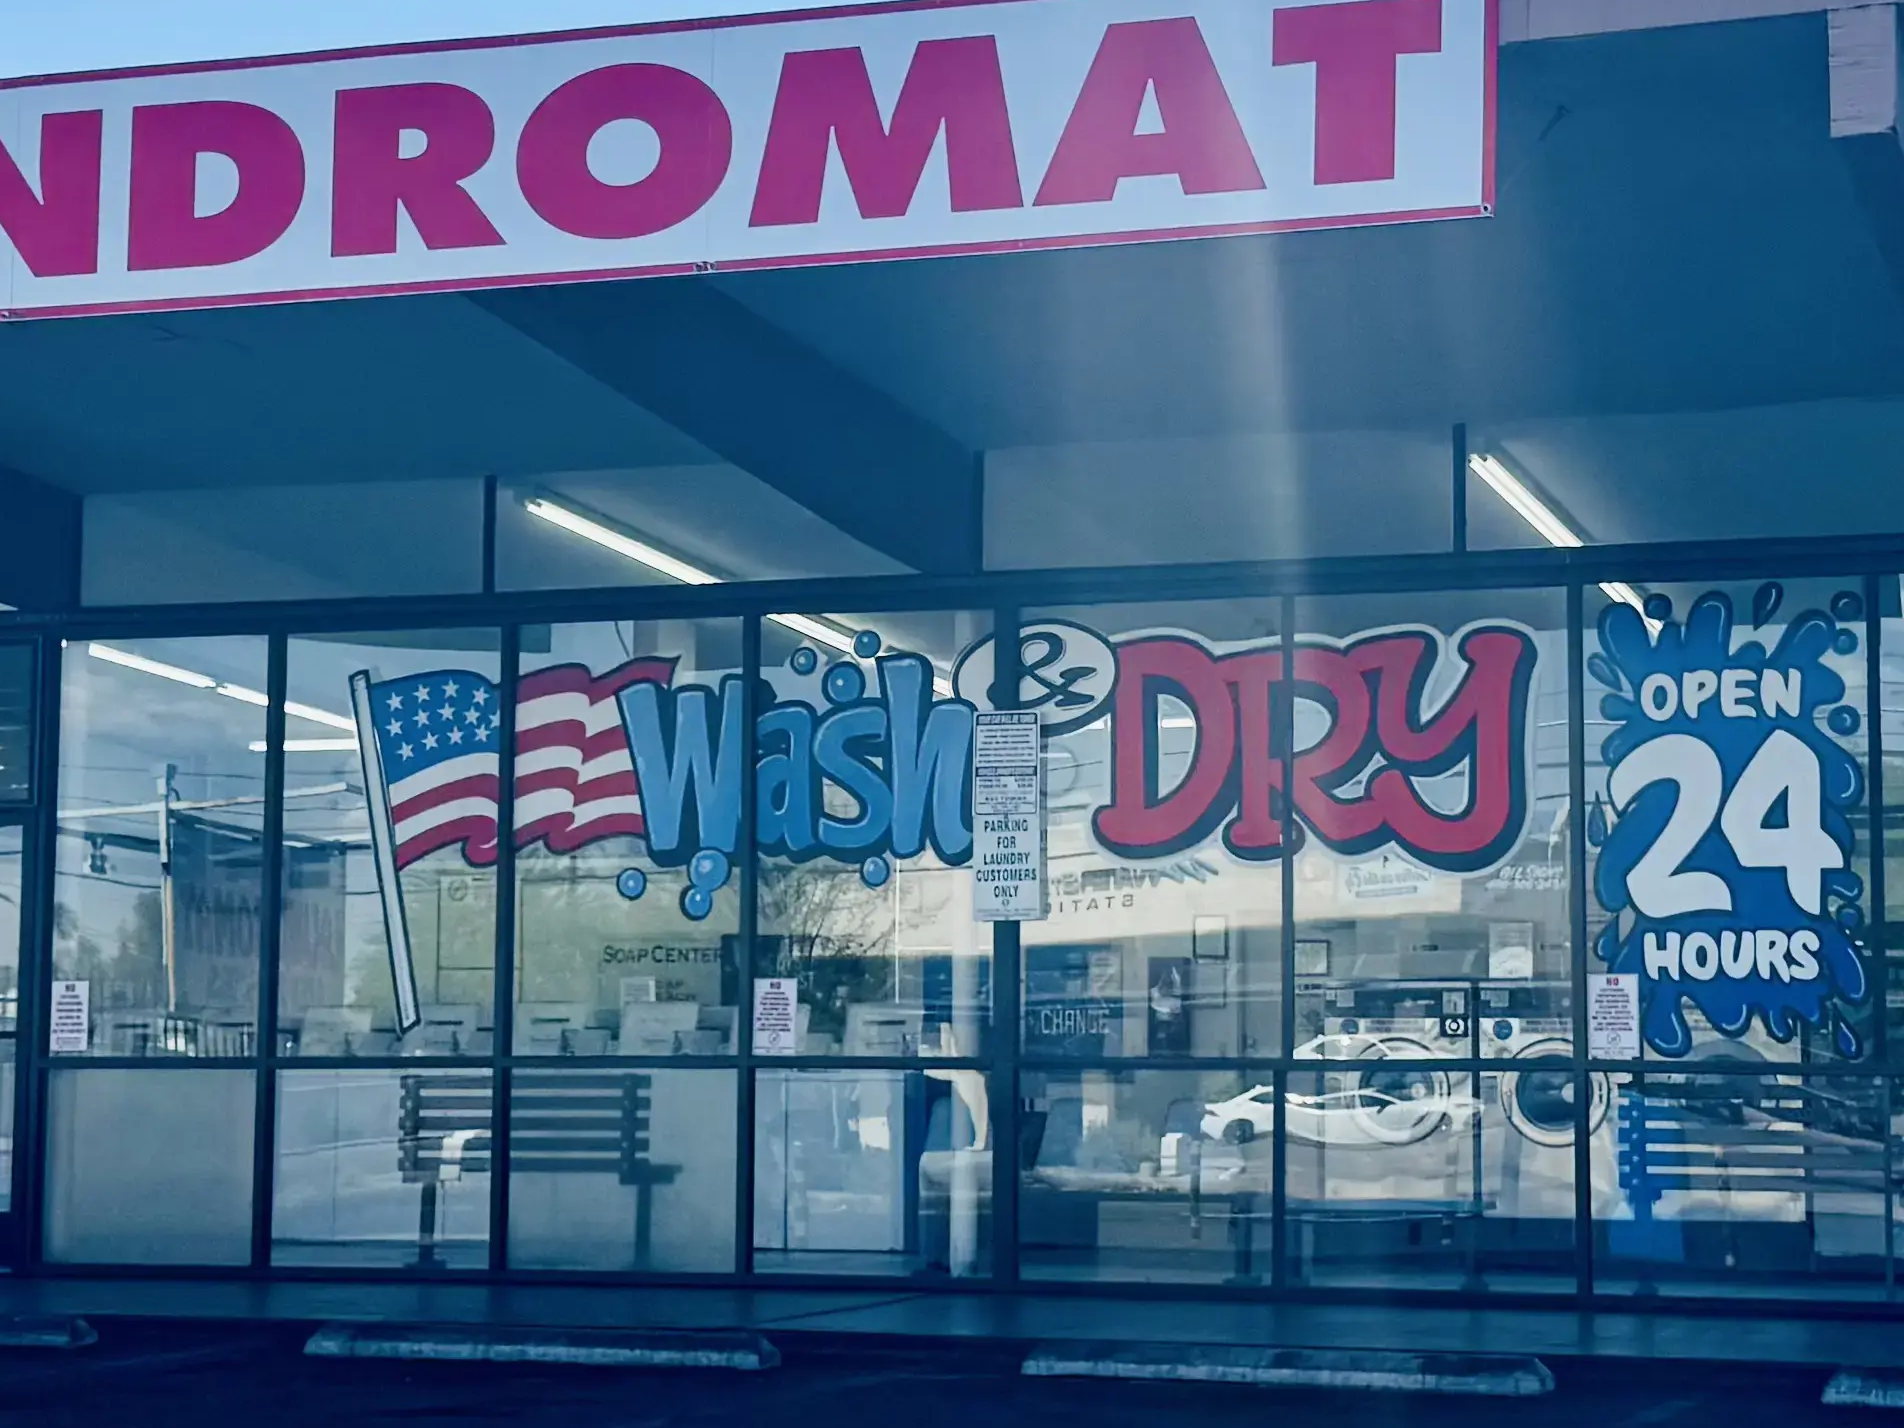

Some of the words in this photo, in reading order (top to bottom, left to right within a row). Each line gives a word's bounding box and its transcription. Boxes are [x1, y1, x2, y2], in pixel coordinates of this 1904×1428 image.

[1641, 668, 1802, 721] OPEN
[615, 651, 975, 867] Wash
[1096, 630, 1527, 857] DRY
[984, 819, 1028, 832] PARKING
[1608, 729, 1844, 919] 24
[997, 836, 1016, 848] FOR
[984, 852, 1030, 865] LAUNDRY
[976, 868, 1037, 882] CUSTOMERS
[994, 885, 1018, 898] ONLY
[603, 944, 649, 963] SOAP
[1643, 930, 1820, 984] HOURS
[1606, 977, 1619, 986] NO
